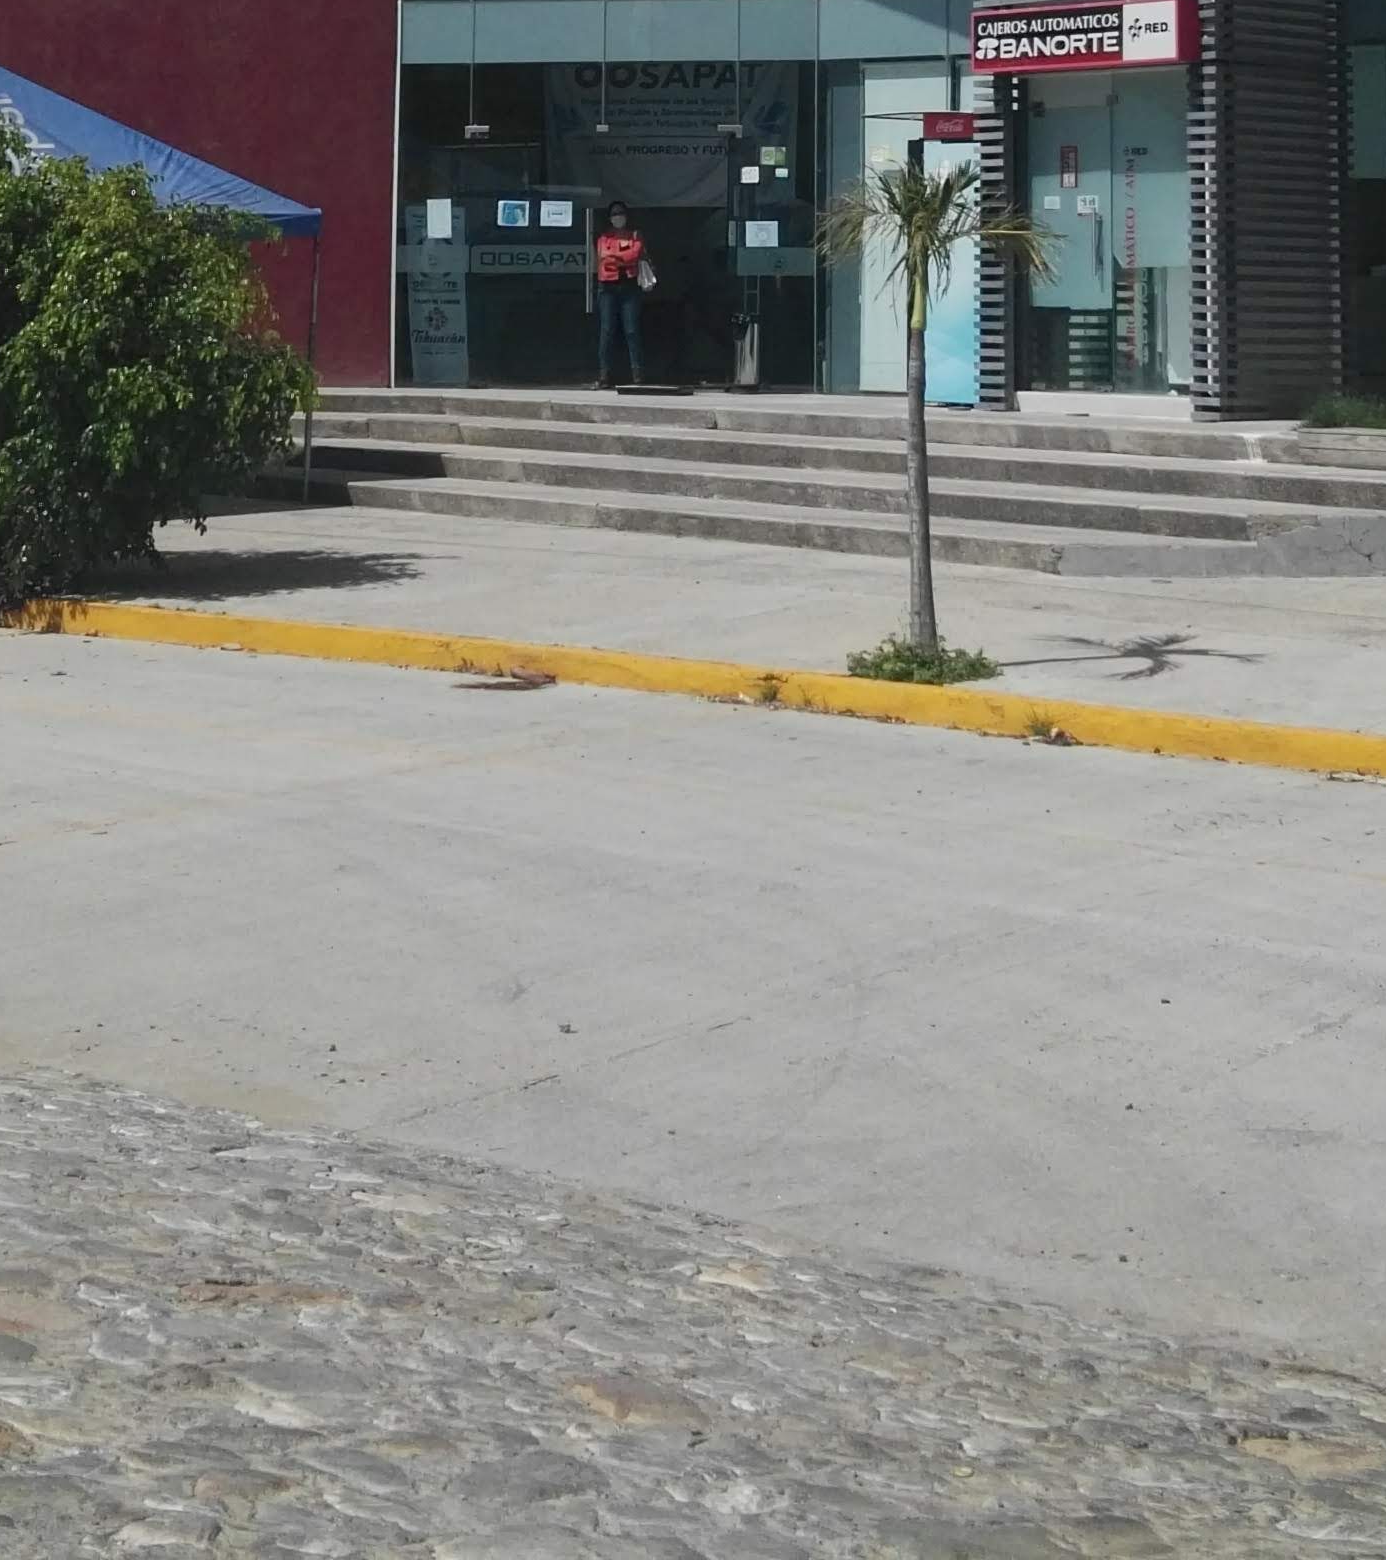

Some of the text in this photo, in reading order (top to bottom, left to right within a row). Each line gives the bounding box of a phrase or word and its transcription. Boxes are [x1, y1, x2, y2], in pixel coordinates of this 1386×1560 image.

[977, 13, 1168, 37] CAJEROS AUTOMATICOS RED
[999, 31, 1120, 59] BANORTE
[574, 63, 763, 89] OOSAPAT
